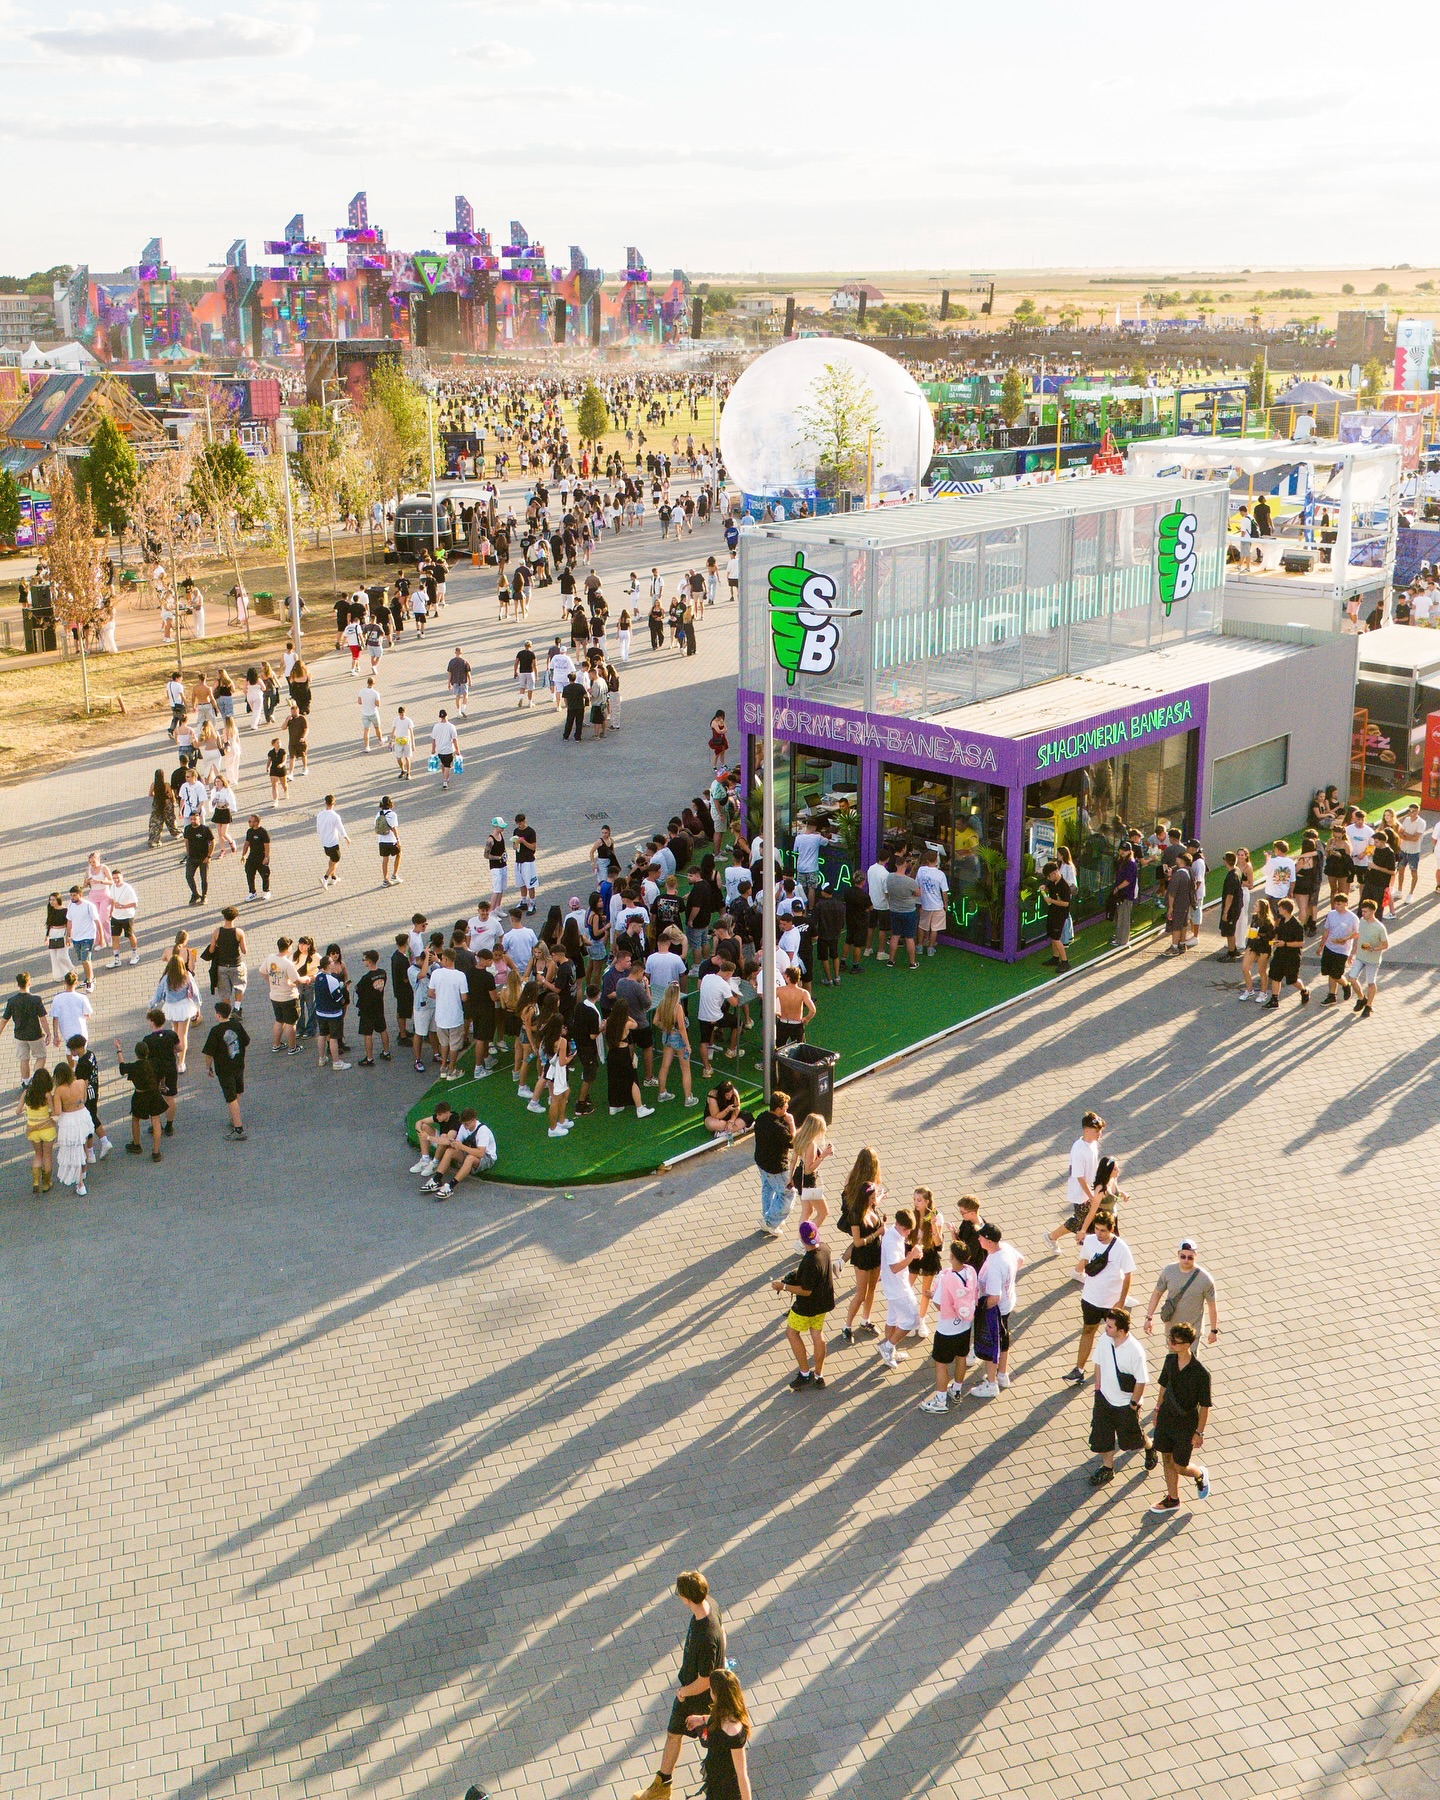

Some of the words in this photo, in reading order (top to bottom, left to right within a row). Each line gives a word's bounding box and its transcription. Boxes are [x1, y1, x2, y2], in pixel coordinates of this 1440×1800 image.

[973, 464, 994, 475] TUBORG
[1067, 457, 1088, 466] TUBORG
[743, 702, 881, 748] SHAORMERIA
[886, 727, 998, 772] BANEASA
[1034, 720, 1128, 770] SHAORMERIA
[1130, 699, 1193, 740] BANEASA
